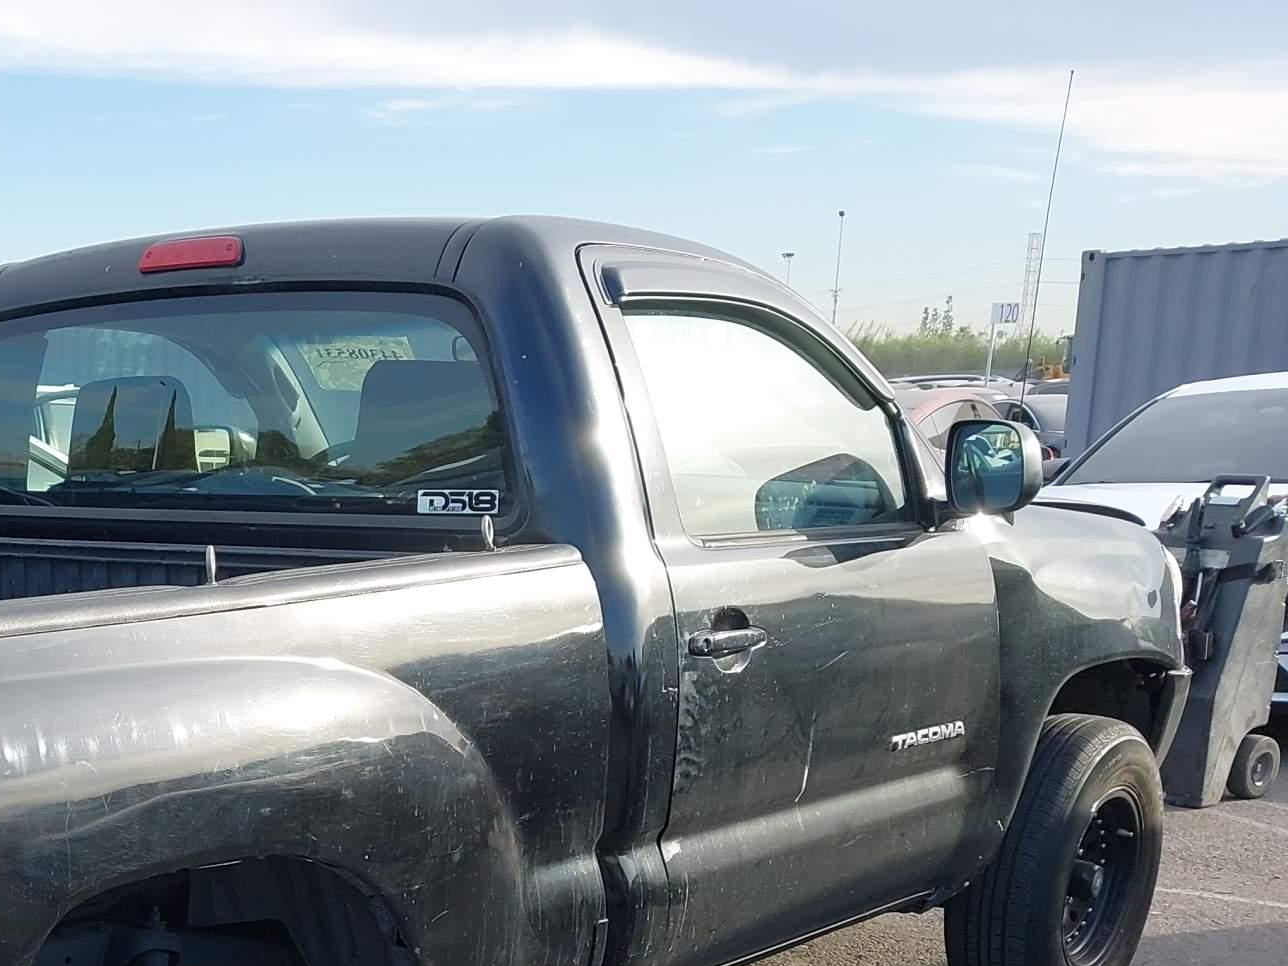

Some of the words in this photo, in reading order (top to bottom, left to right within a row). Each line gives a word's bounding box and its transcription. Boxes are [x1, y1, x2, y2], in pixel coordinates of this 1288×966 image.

[1000, 303, 1019, 323] 120
[420, 491, 497, 512] DS18
[891, 721, 965, 751] TACOMA
